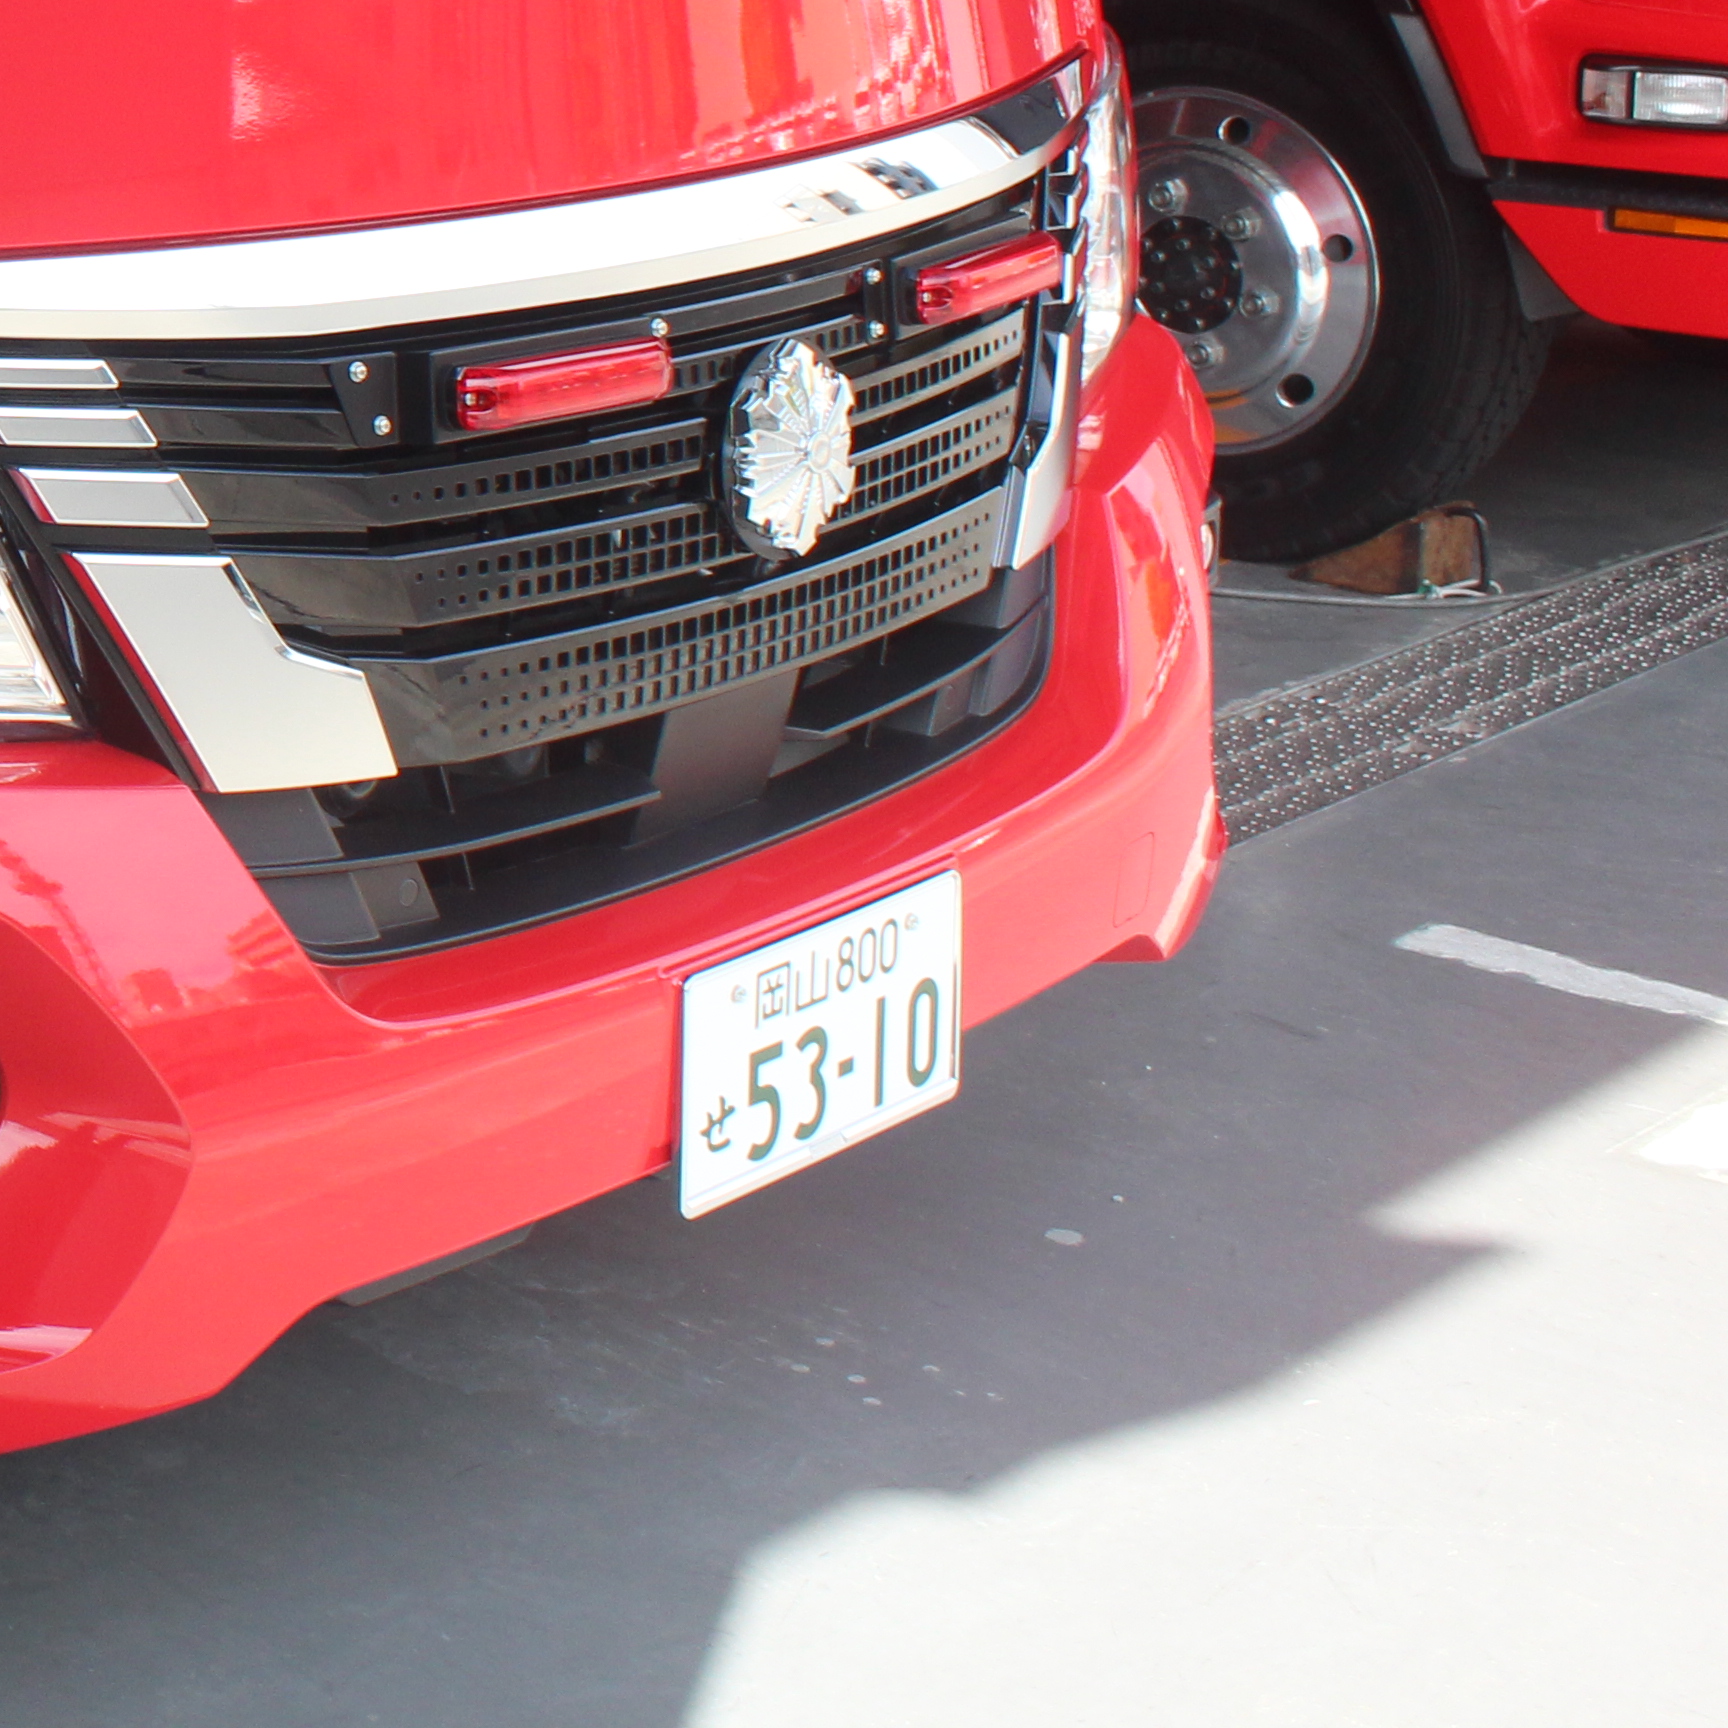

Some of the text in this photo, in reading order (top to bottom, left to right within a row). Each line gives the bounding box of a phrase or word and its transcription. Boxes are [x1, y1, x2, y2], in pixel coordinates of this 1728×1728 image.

[754, 918, 899, 1029] 岡山 800
[699, 977, 939, 1162] せ 53-10
